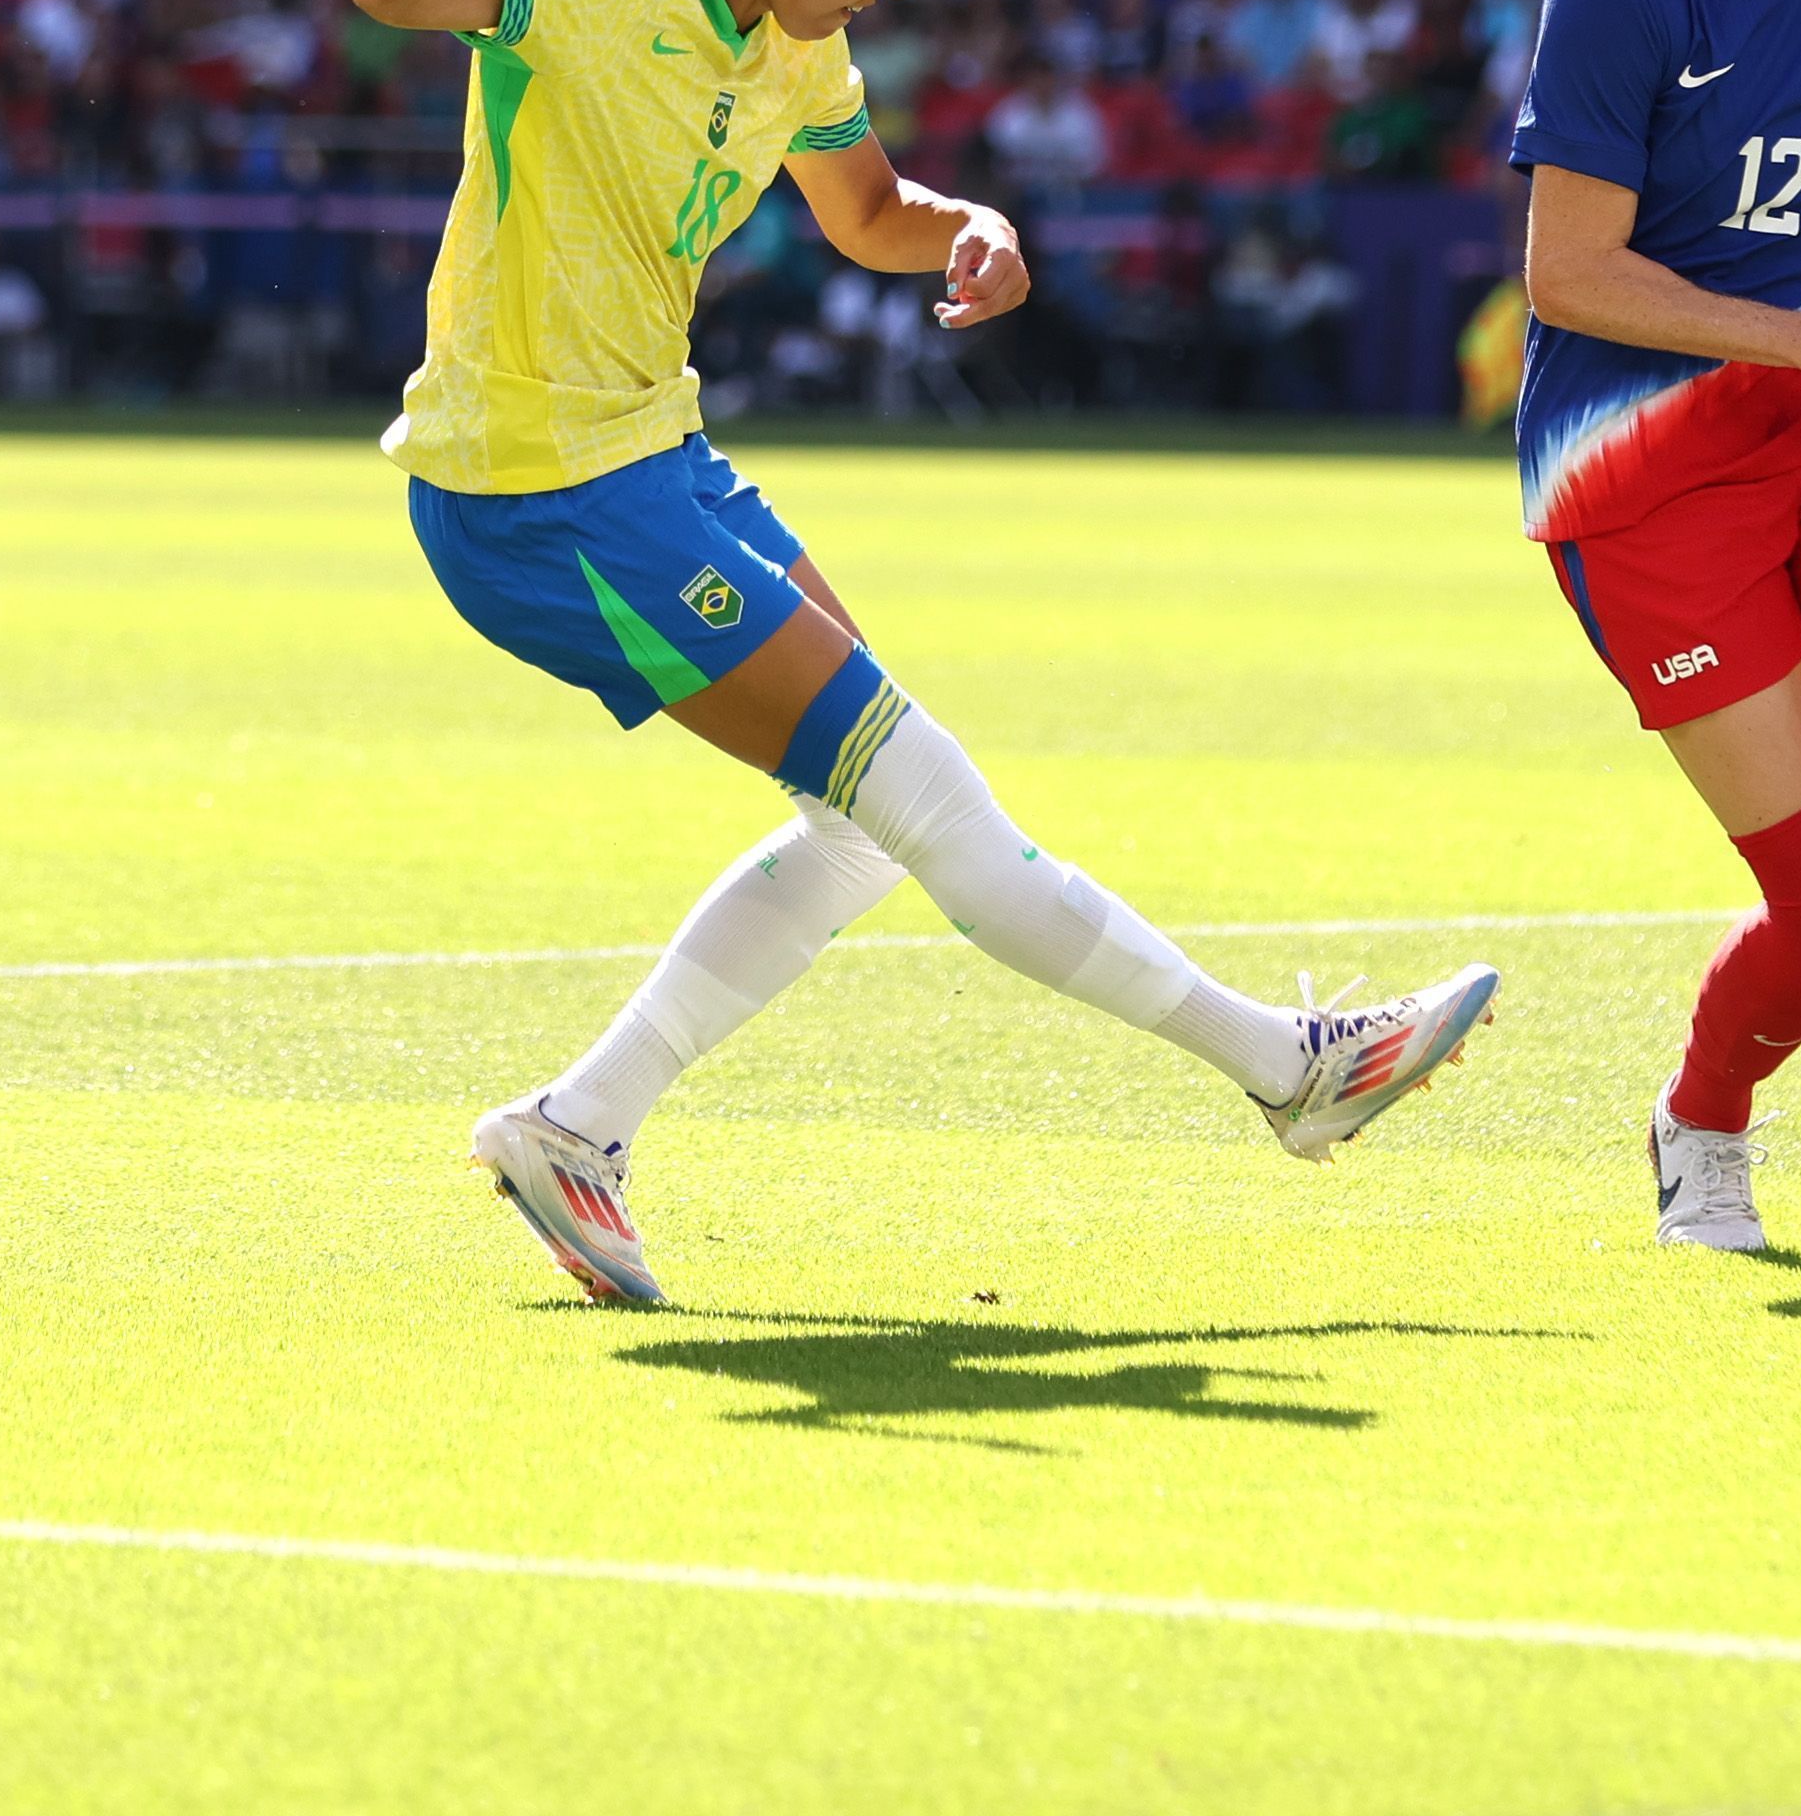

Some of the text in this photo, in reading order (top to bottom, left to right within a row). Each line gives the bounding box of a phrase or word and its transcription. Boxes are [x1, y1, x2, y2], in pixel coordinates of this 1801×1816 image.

[665, 159, 742, 265] 18
[684, 572, 717, 603] BRASIL
[1651, 644, 1720, 686] USA
[538, 1138, 602, 1184] F50
